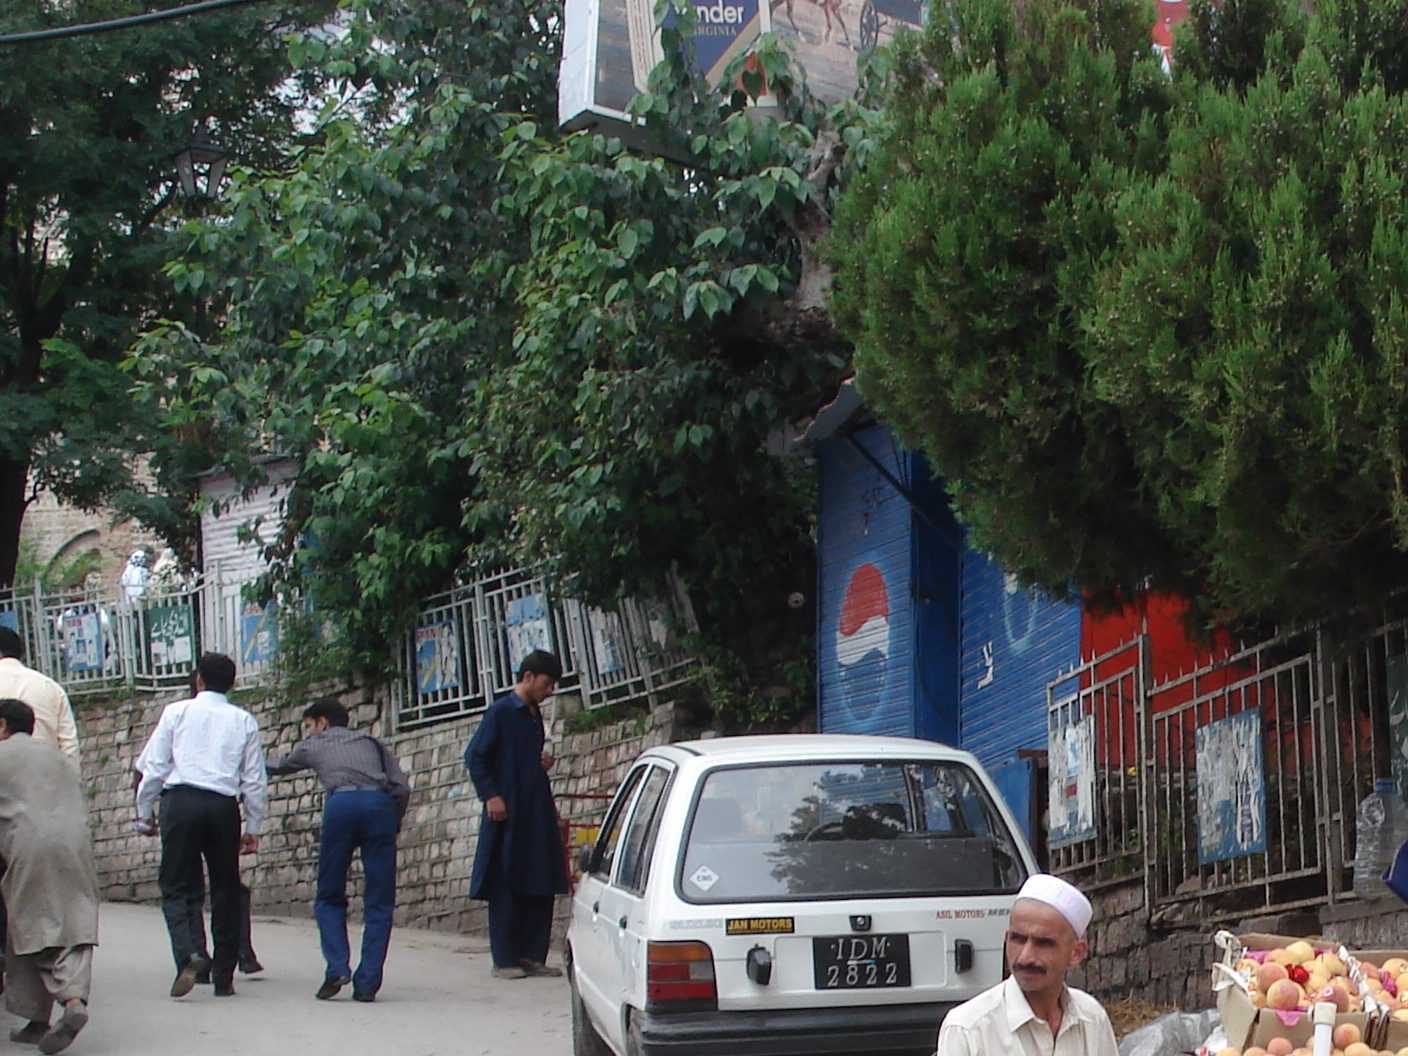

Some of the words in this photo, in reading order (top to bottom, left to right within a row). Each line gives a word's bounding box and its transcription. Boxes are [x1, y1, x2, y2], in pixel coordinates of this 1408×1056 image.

[692, 25, 738, 37] IRGINIA
[728, 919, 748, 931] JAN
[750, 918, 793, 930] MOTORS
[836, 937, 888, 961] IDM
[826, 963, 898, 988] 2822
